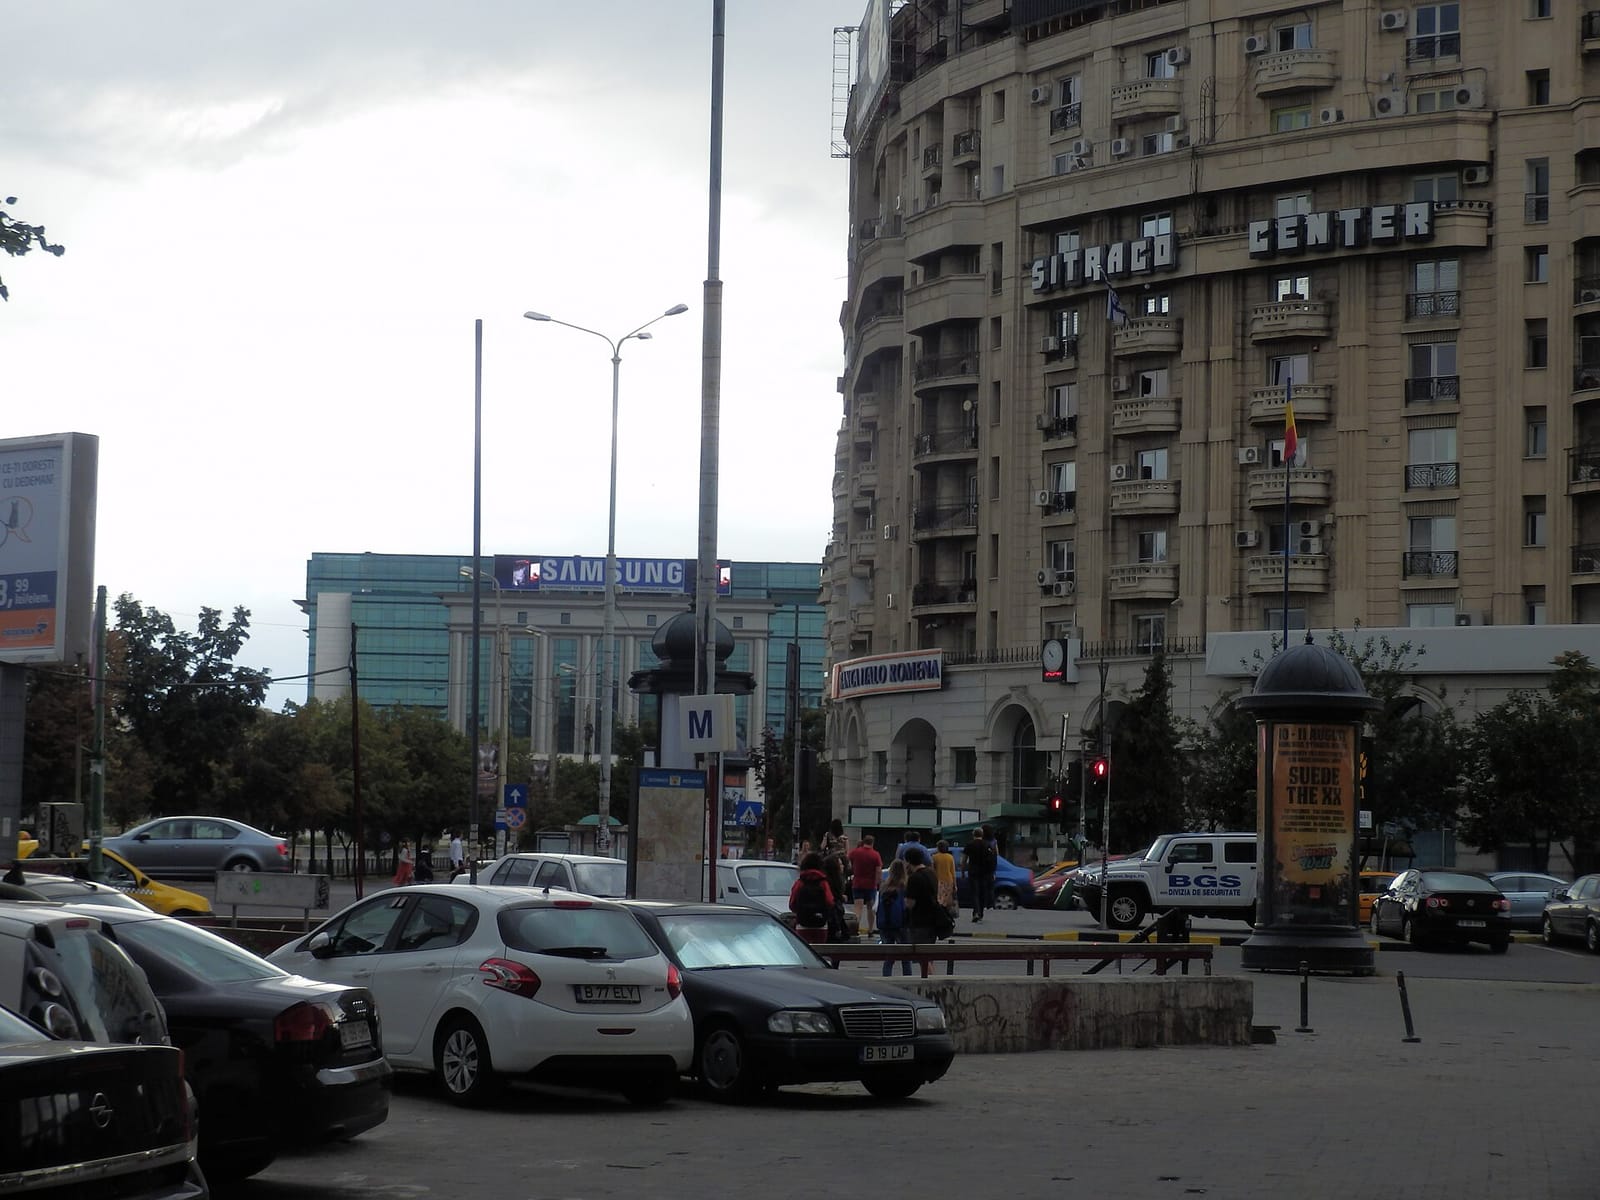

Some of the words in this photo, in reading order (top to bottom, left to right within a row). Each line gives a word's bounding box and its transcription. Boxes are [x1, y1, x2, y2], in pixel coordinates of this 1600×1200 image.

[1249, 202, 1431, 254] CENTER
[688, 710, 713, 739] M
[1289, 766, 1340, 785] SUEDE
[1286, 786, 1318, 805] THE
[1322, 786, 1342, 806] XX
[1168, 875, 1242, 888] BGS
[1168, 889, 1192, 897] DIVIZIA
[1192, 889, 1201, 897] DE
[1202, 889, 1241, 897] SECURITATE
[584, 986, 593, 999] B
[596, 986, 609, 999] 77
[613, 986, 635, 999] ELY
[866, 1047, 874, 1060] B
[878, 1047, 887, 1059] 19
